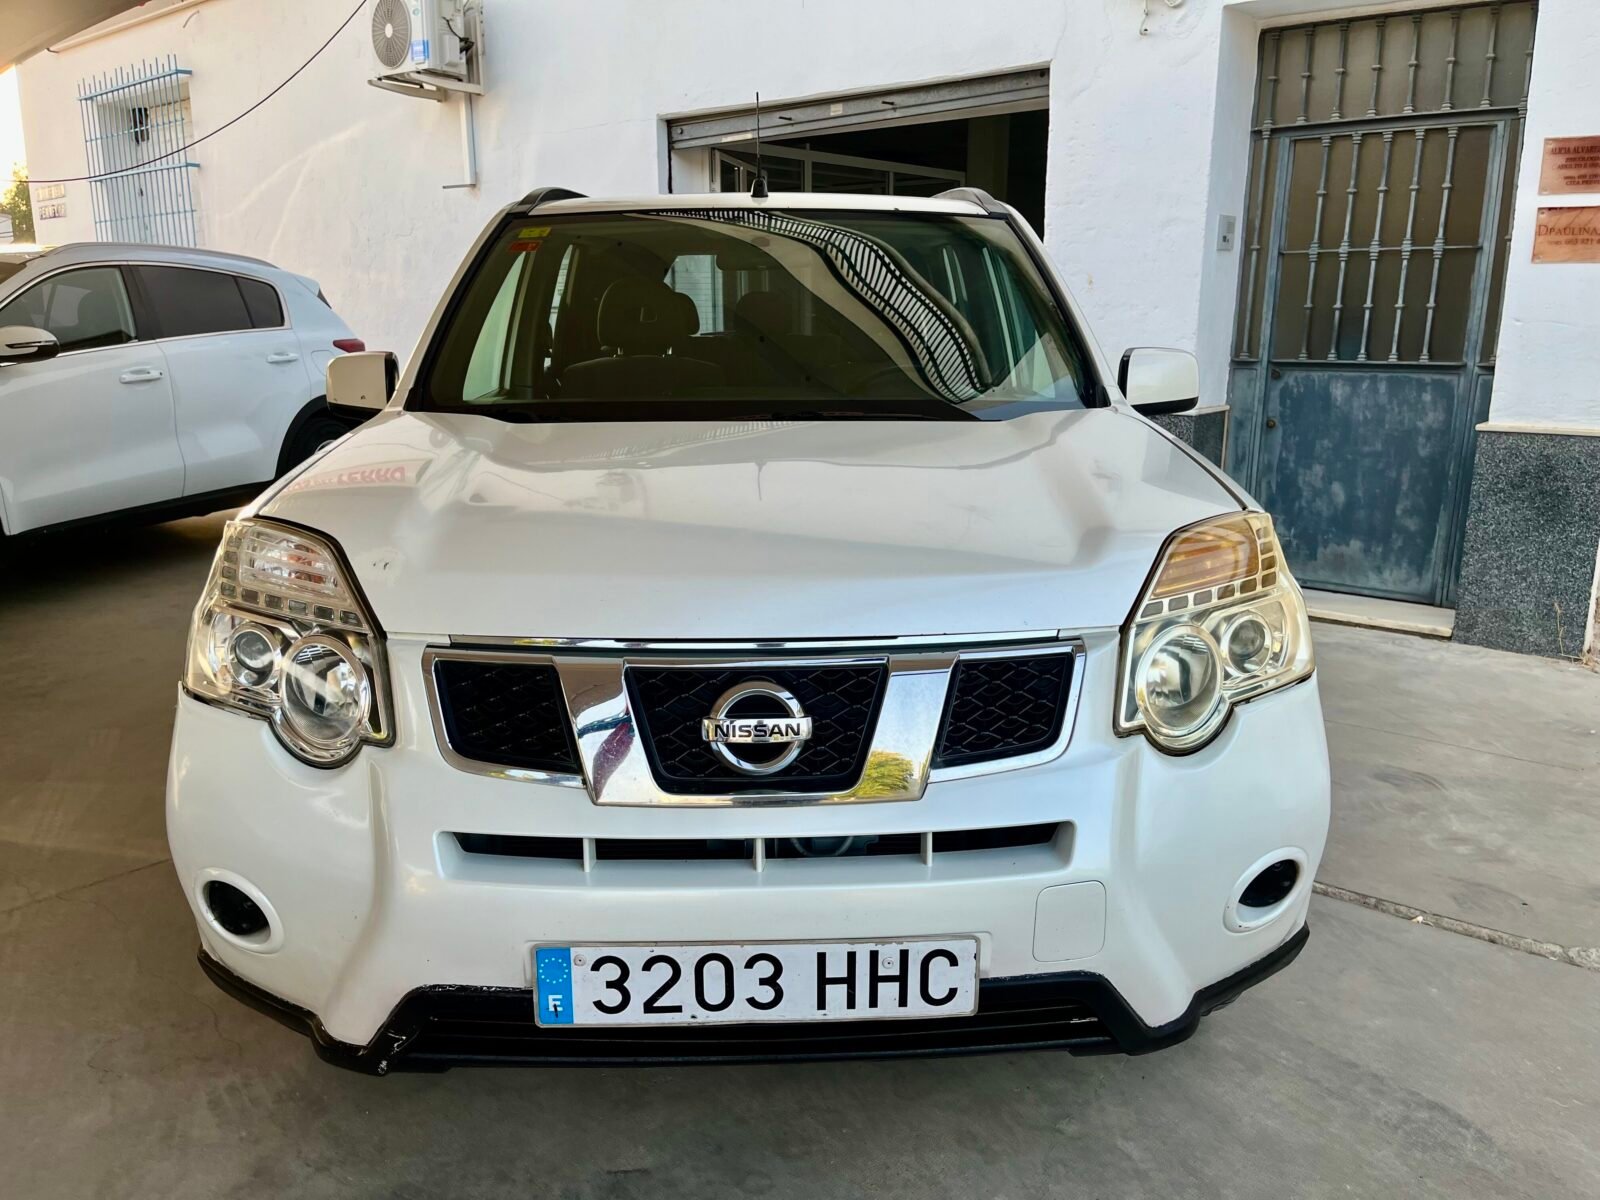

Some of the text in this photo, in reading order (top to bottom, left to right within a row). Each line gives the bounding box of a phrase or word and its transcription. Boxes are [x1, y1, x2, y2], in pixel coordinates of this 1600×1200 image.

[714, 723, 801, 738] NISSAN
[590, 948, 960, 1014] 3203 HHC
